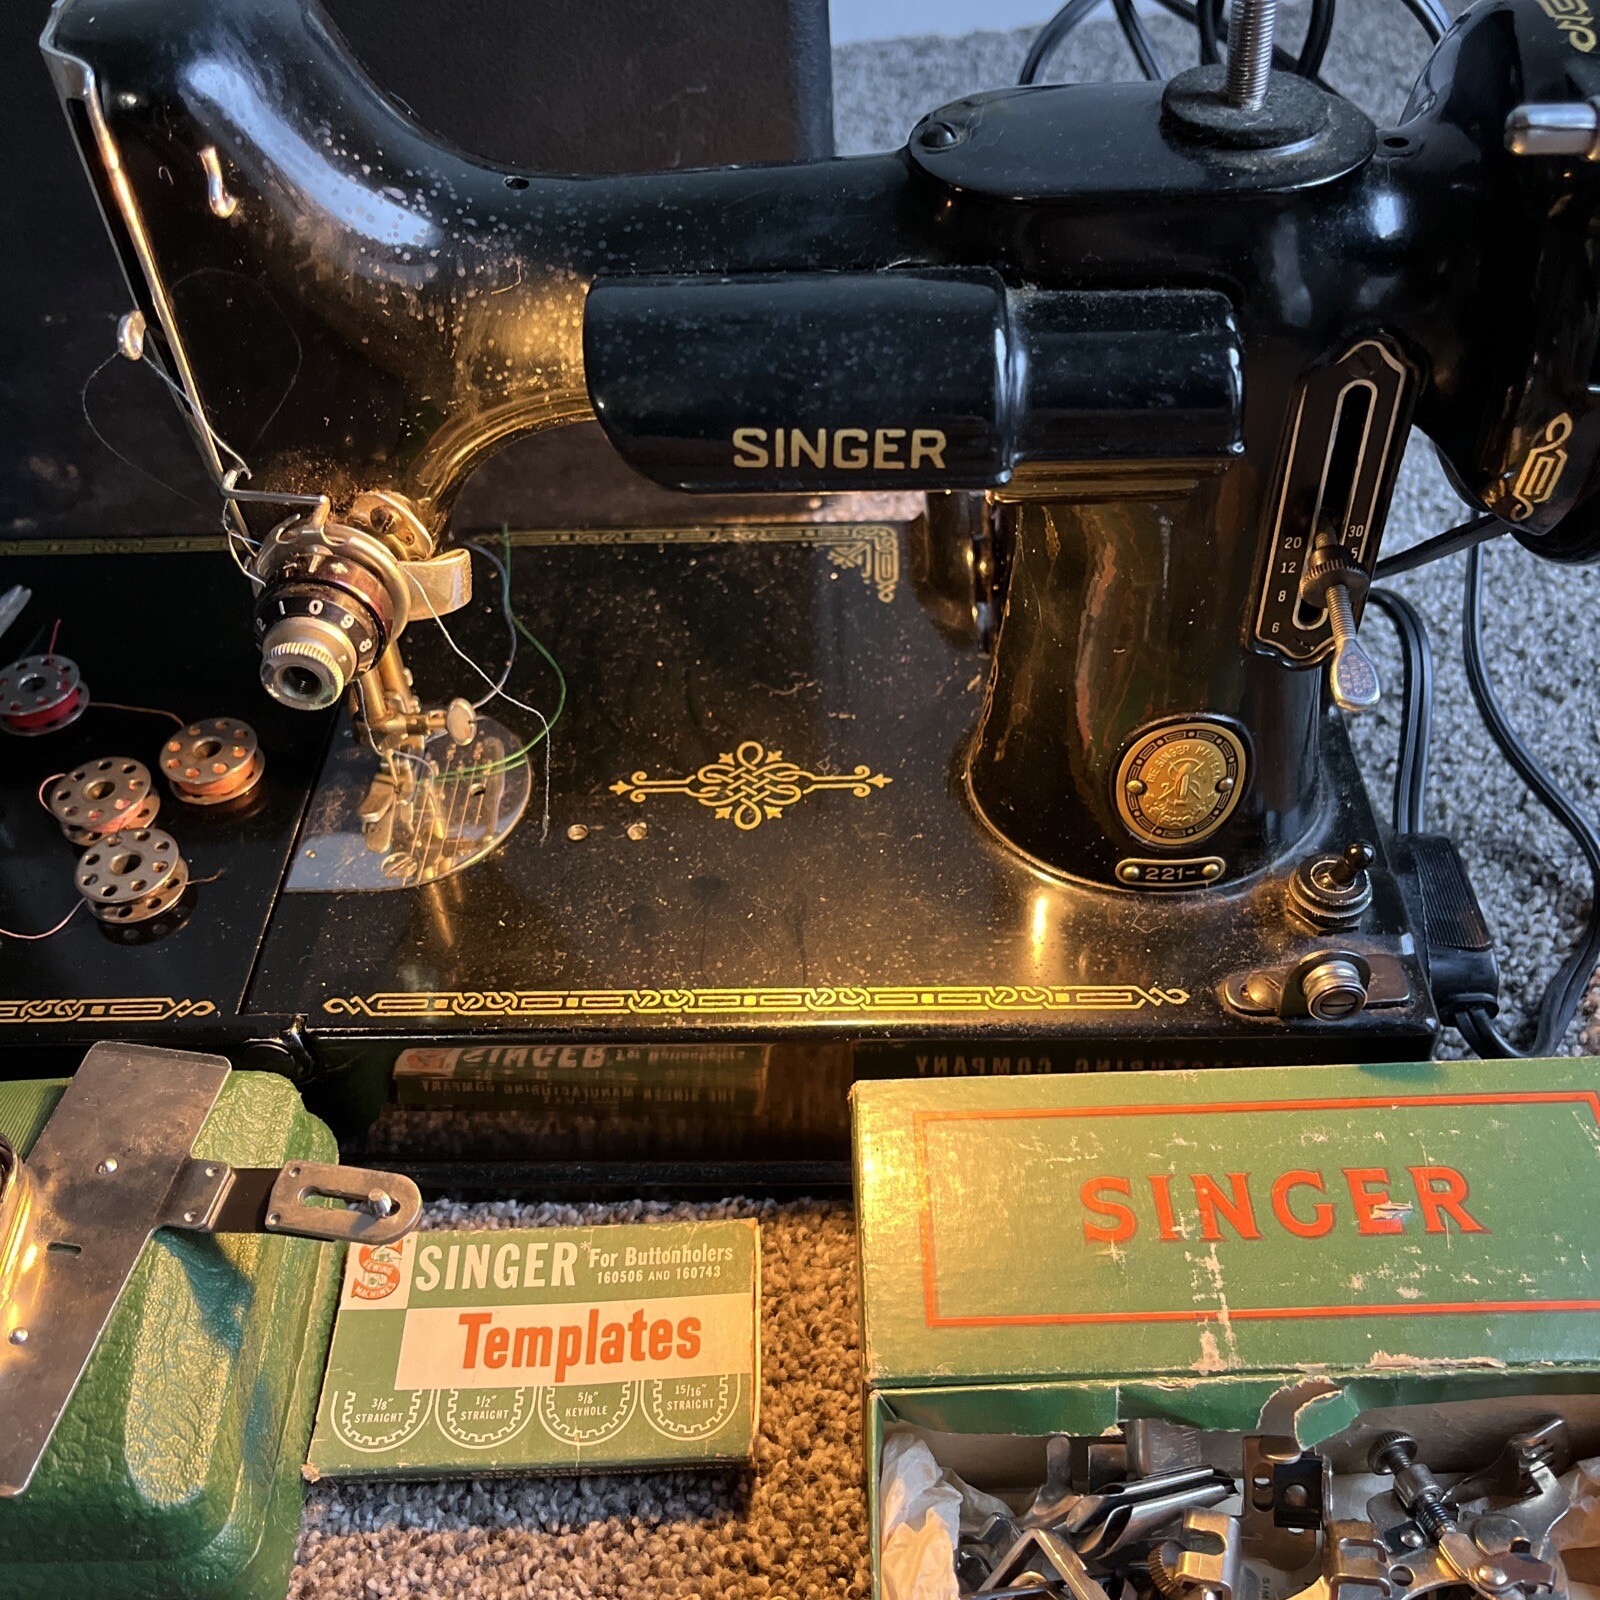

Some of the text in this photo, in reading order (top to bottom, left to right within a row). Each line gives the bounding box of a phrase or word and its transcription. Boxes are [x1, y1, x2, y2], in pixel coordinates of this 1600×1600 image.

[732, 427, 947, 469] SINGER
[1348, 525, 1364, 537] 30
[1284, 537, 1302, 549] 20
[1351, 547, 1358, 559] 5
[1280, 562, 1296, 574] 12
[1277, 590, 1286, 602] 8
[309, 600, 323, 615] 0
[340, 614, 355, 629] 9
[359, 638, 373, 653] 8
[1271, 622, 1280, 634] 6
[1155, 745, 1190, 768] SINGER
[1145, 867, 1196, 881] 221-
[1080, 1165, 1492, 1244] SINGER
[589, 1243, 734, 1268] For Buttonholers
[415, 1241, 578, 1292] SINGER
[597, 1265, 721, 1284] 160506 AND 160743
[458, 1308, 702, 1382] Templates
[565, 1405, 608, 1417] KEYHOLE
[667, 1398, 714, 1411] STRAIGHT
[354, 1412, 403, 1424] STRAIGHT
[460, 1409, 509, 1421] STRAIGHT
